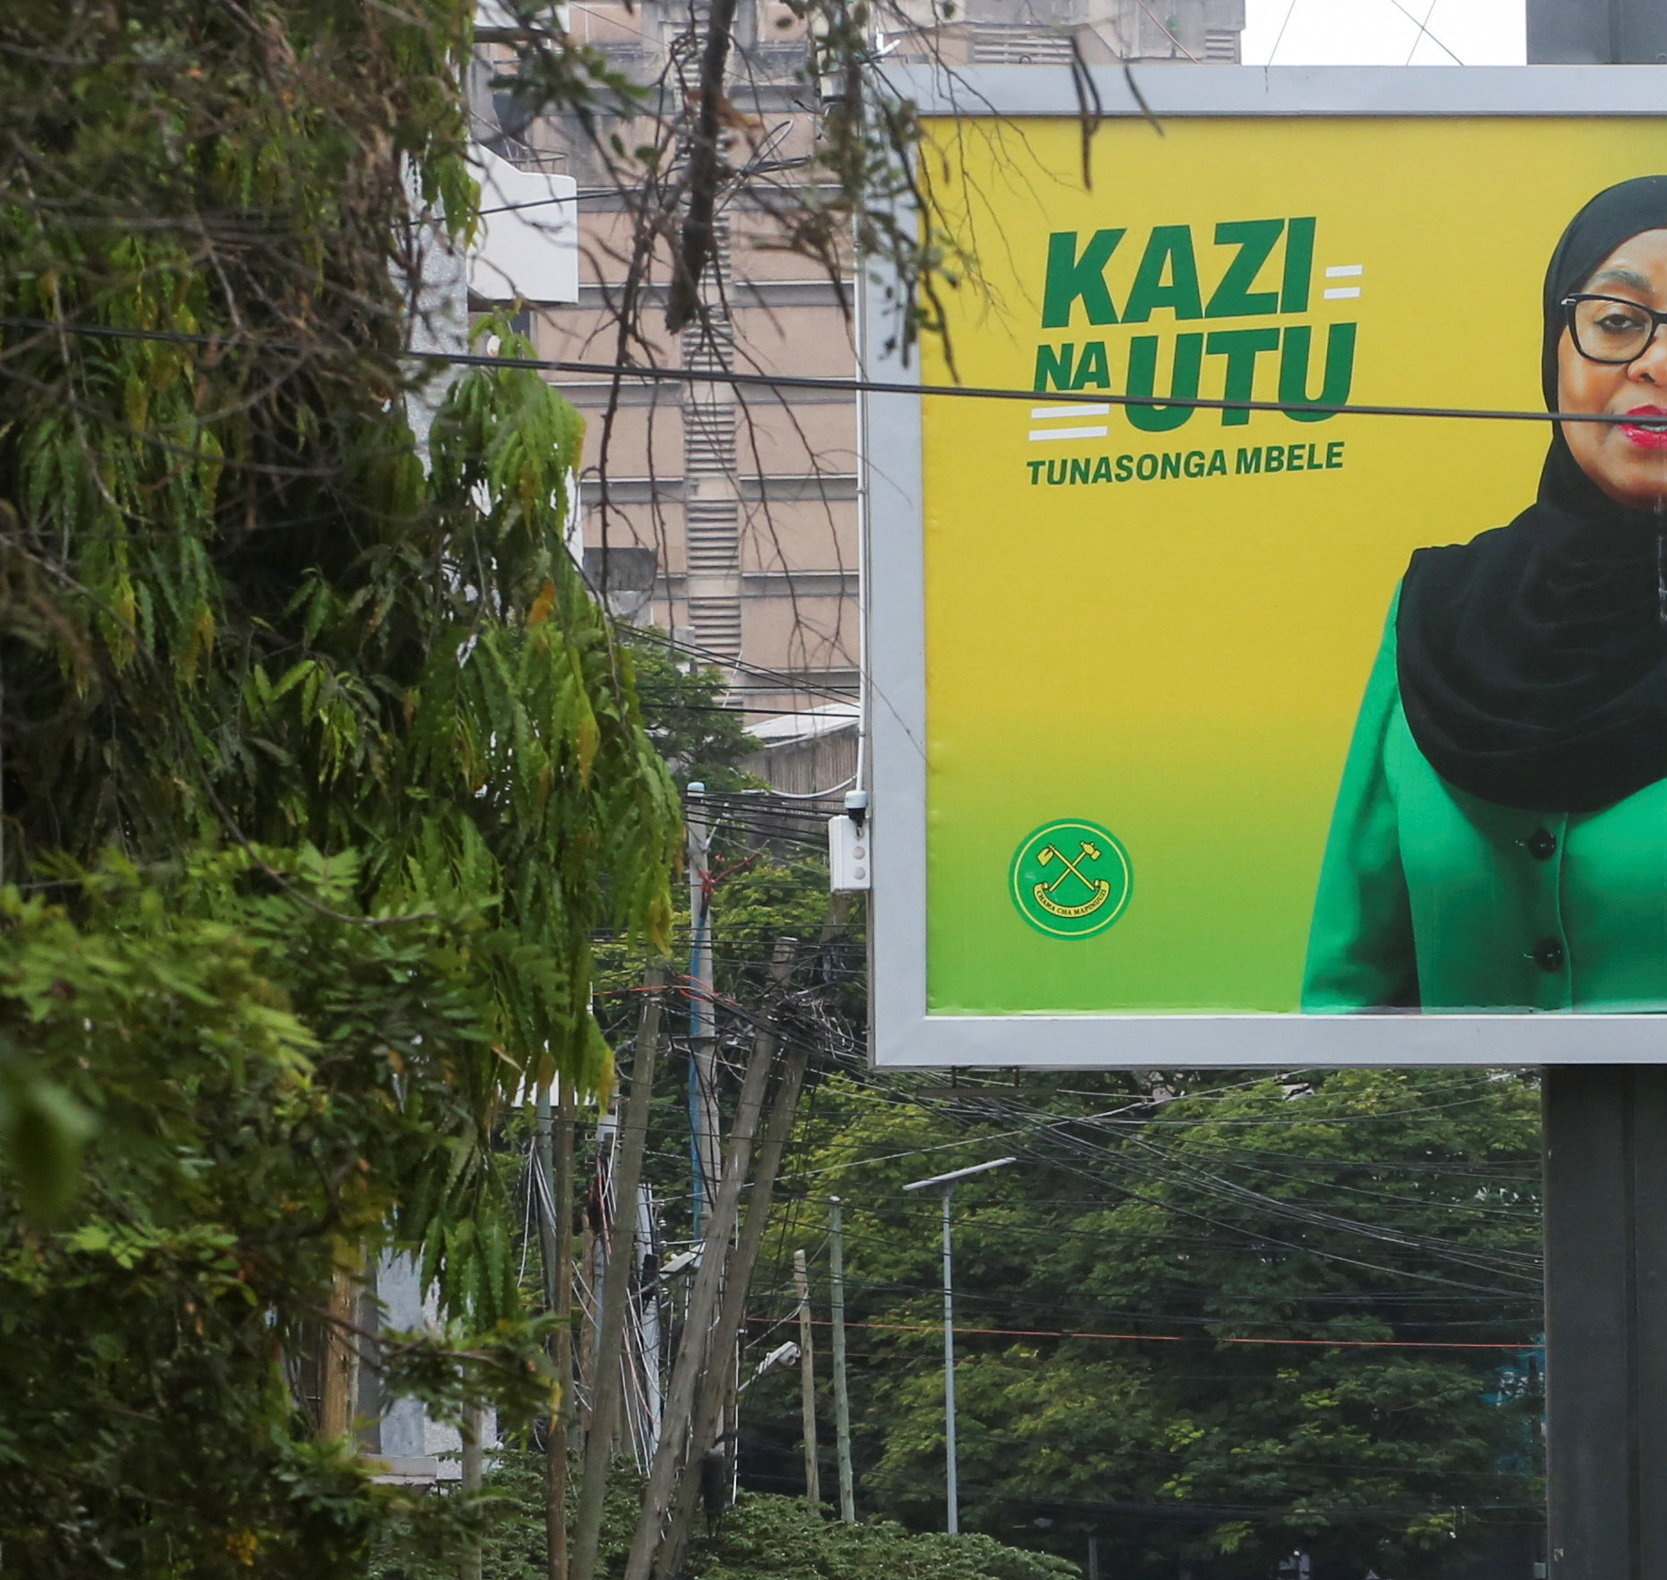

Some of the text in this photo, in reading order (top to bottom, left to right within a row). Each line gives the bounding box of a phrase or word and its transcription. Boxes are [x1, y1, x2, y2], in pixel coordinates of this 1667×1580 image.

[1041, 216, 1317, 329] KAZI
[1033, 322, 1358, 433] NA UTU
[1026, 441, 1346, 486] TUNASONGA MBELE
